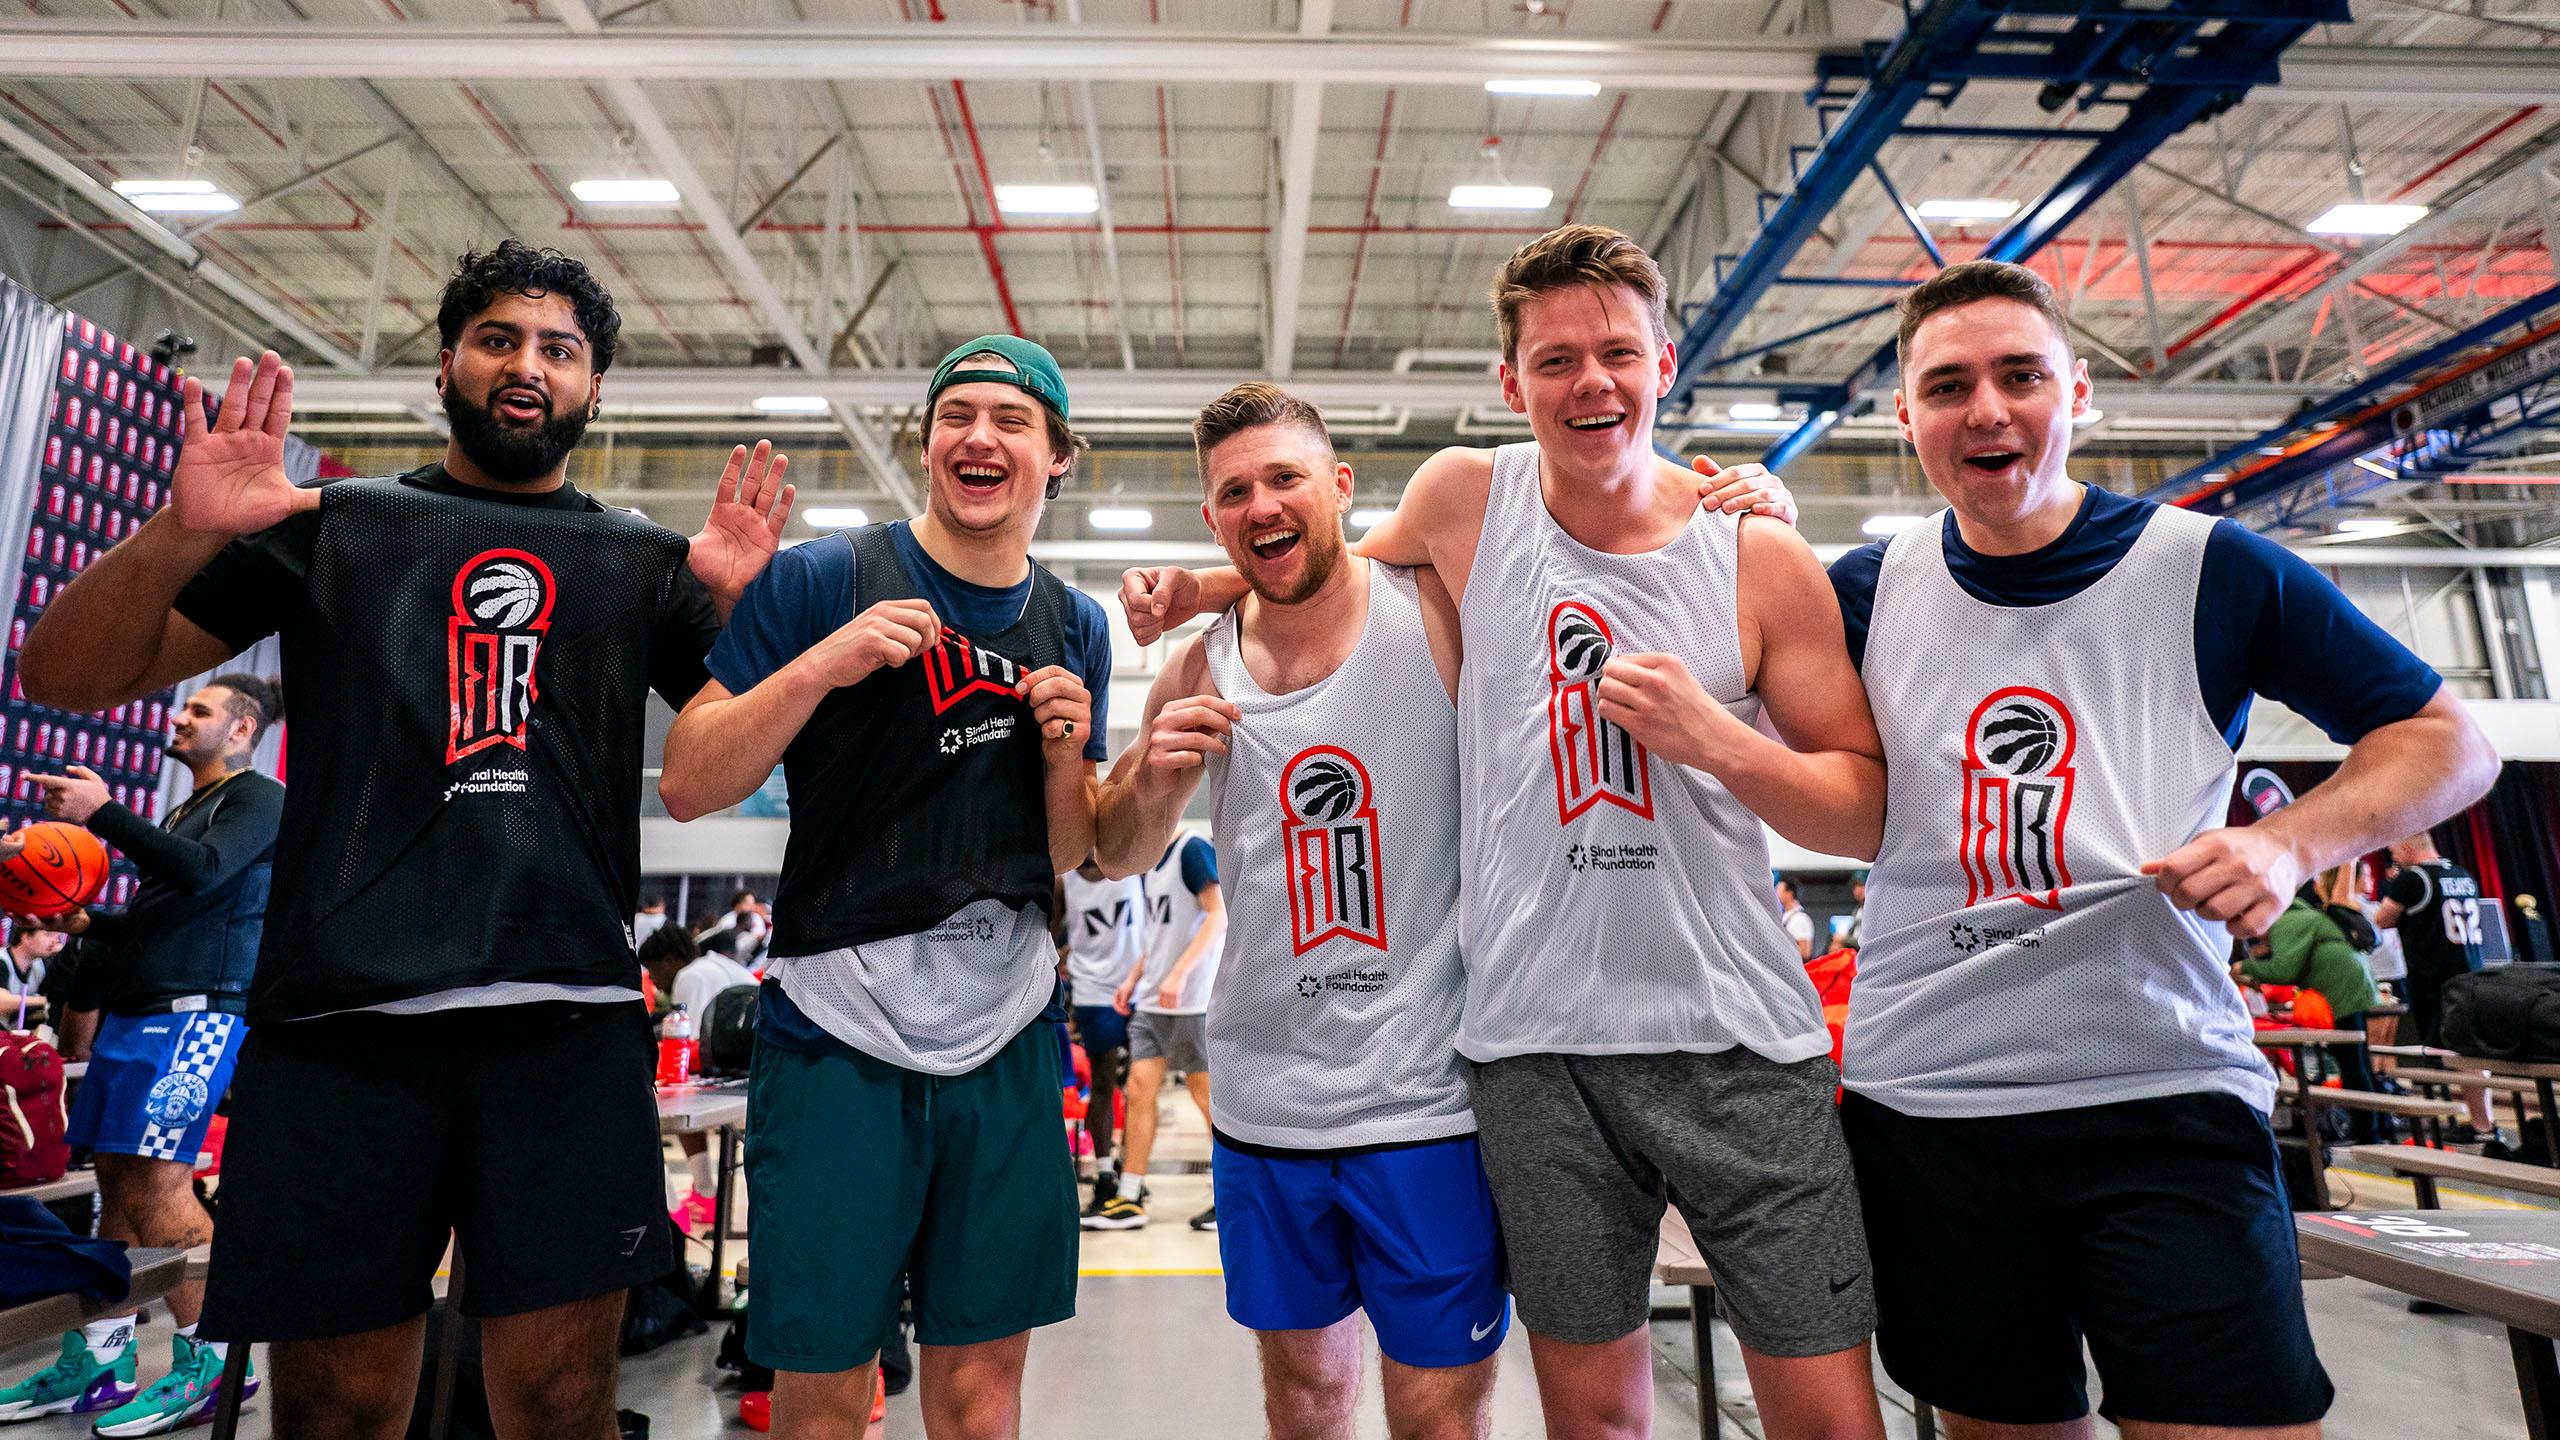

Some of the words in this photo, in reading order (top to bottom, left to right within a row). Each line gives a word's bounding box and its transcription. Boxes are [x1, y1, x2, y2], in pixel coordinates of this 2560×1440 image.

[469, 768, 490, 781] nai
[492, 768, 529, 781] Health
[1590, 844, 1616, 858] Sinai
[1618, 843, 1658, 858] Health
[1591, 857, 1655, 870] Foundation
[2441, 898, 2483, 945] 62
[1982, 927, 2016, 940] Sinai
[1353, 968, 1389, 981] Health
[1325, 981, 1384, 993] Foundation
